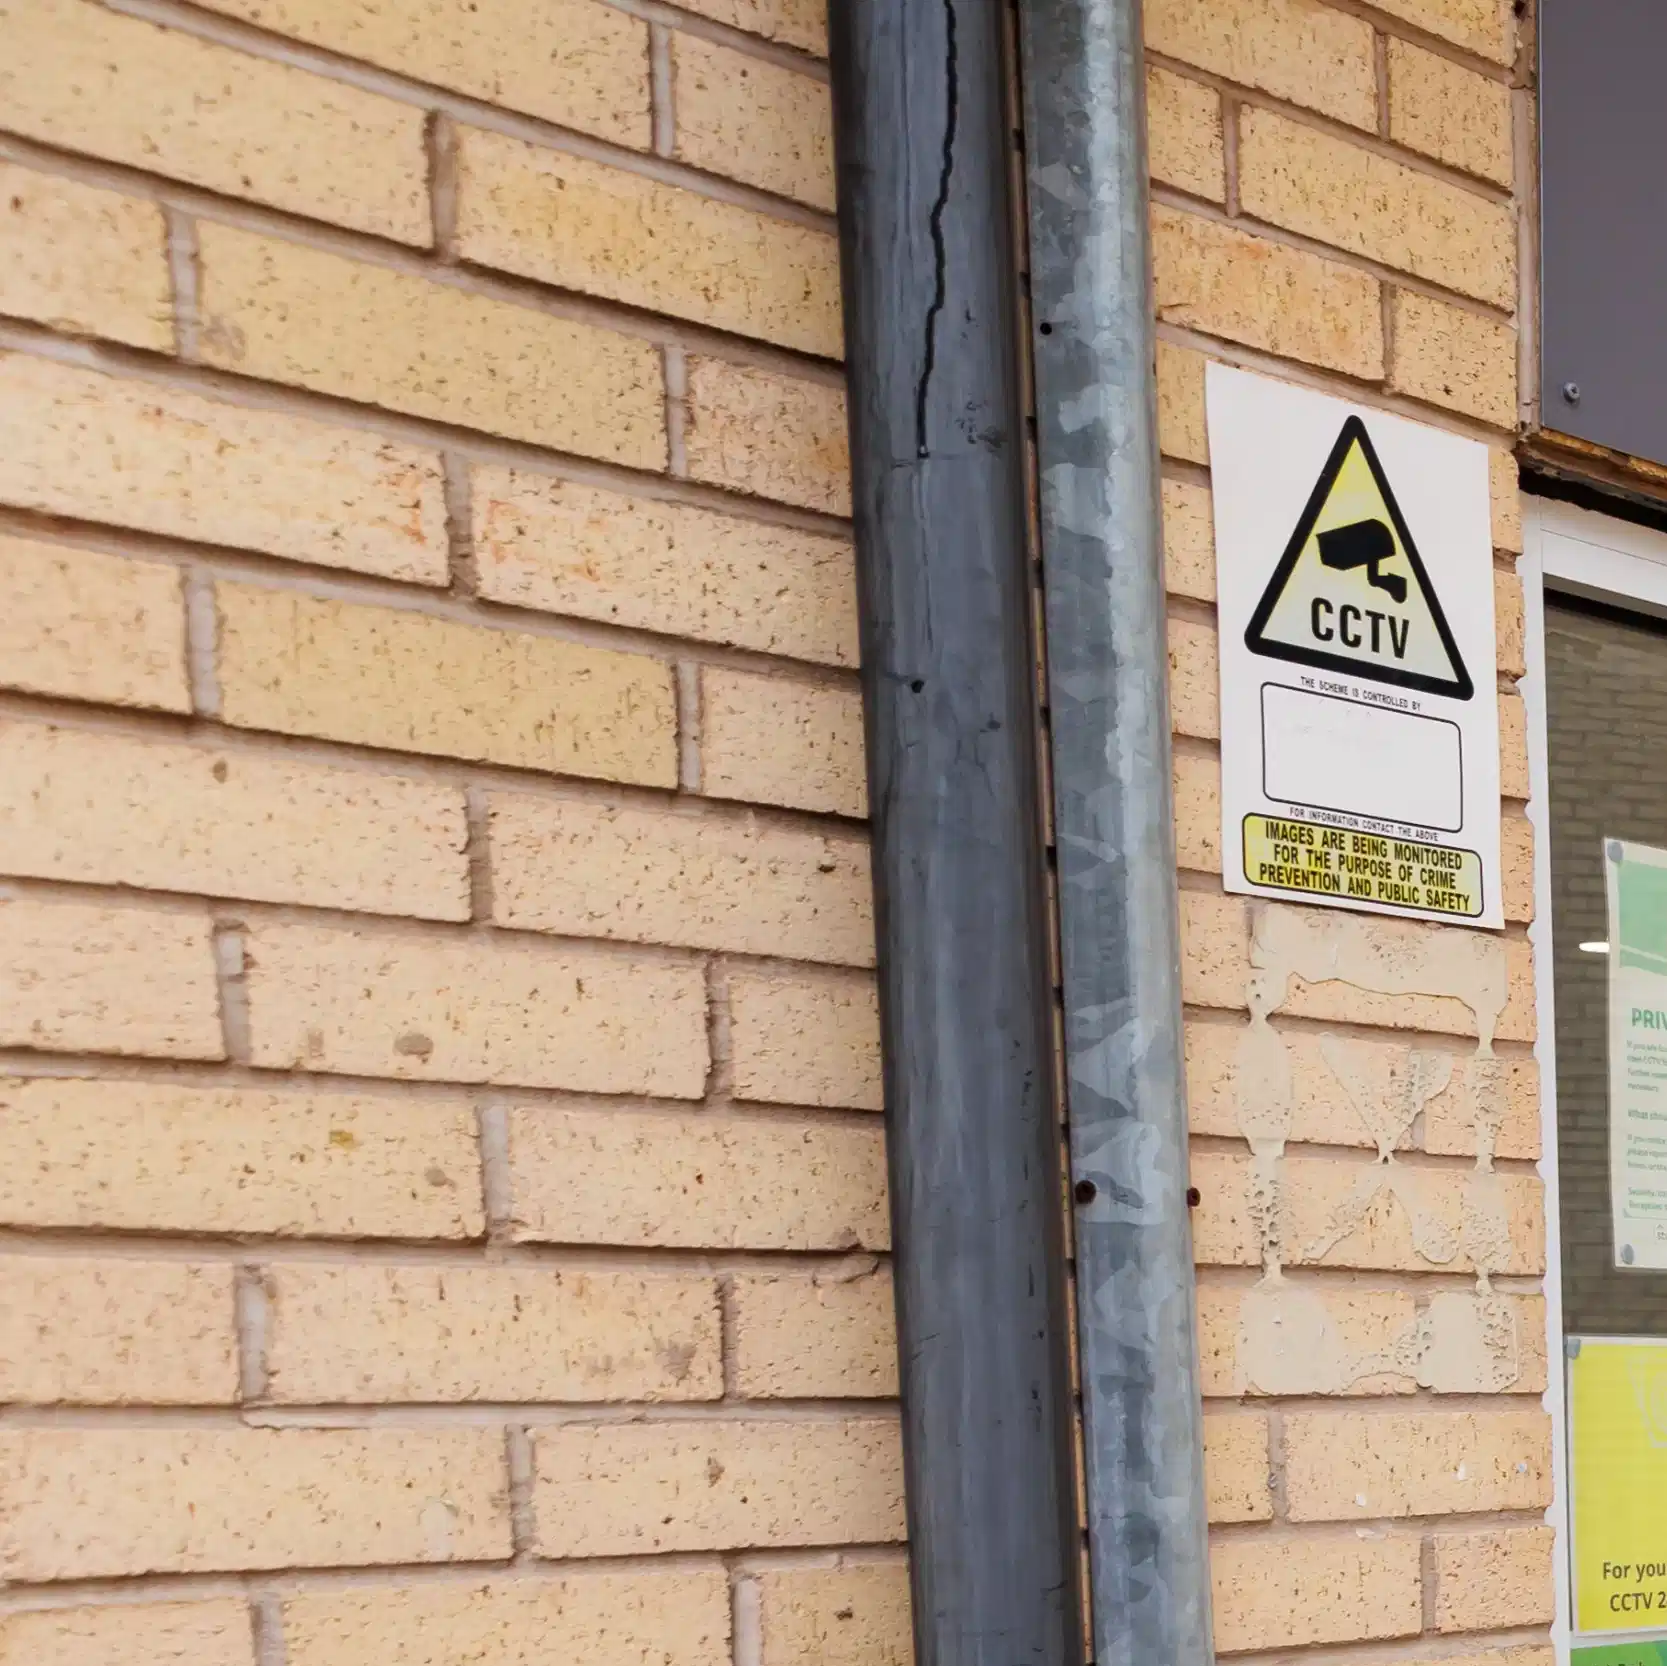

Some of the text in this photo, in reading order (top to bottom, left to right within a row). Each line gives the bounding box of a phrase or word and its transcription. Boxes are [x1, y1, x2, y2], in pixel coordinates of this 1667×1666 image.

[1311, 596, 1411, 660] CCTV
[1300, 676, 1421, 711] THE SCHEME IS CONTROLLED BY
[1290, 807, 1439, 842] FOR INFORMATION CONTACT THE ABOVE
[1266, 820, 1463, 870] IMAGES ARE BEING MONITORED
[1274, 844, 1456, 890] FOR THE PURPOSE OF CRIME
[1259, 864, 1470, 911] PREVENTION AND PUBLIC SAFETY
[1603, 1561, 1631, 1580] For
[1609, 1592, 1653, 1612] CCTV
